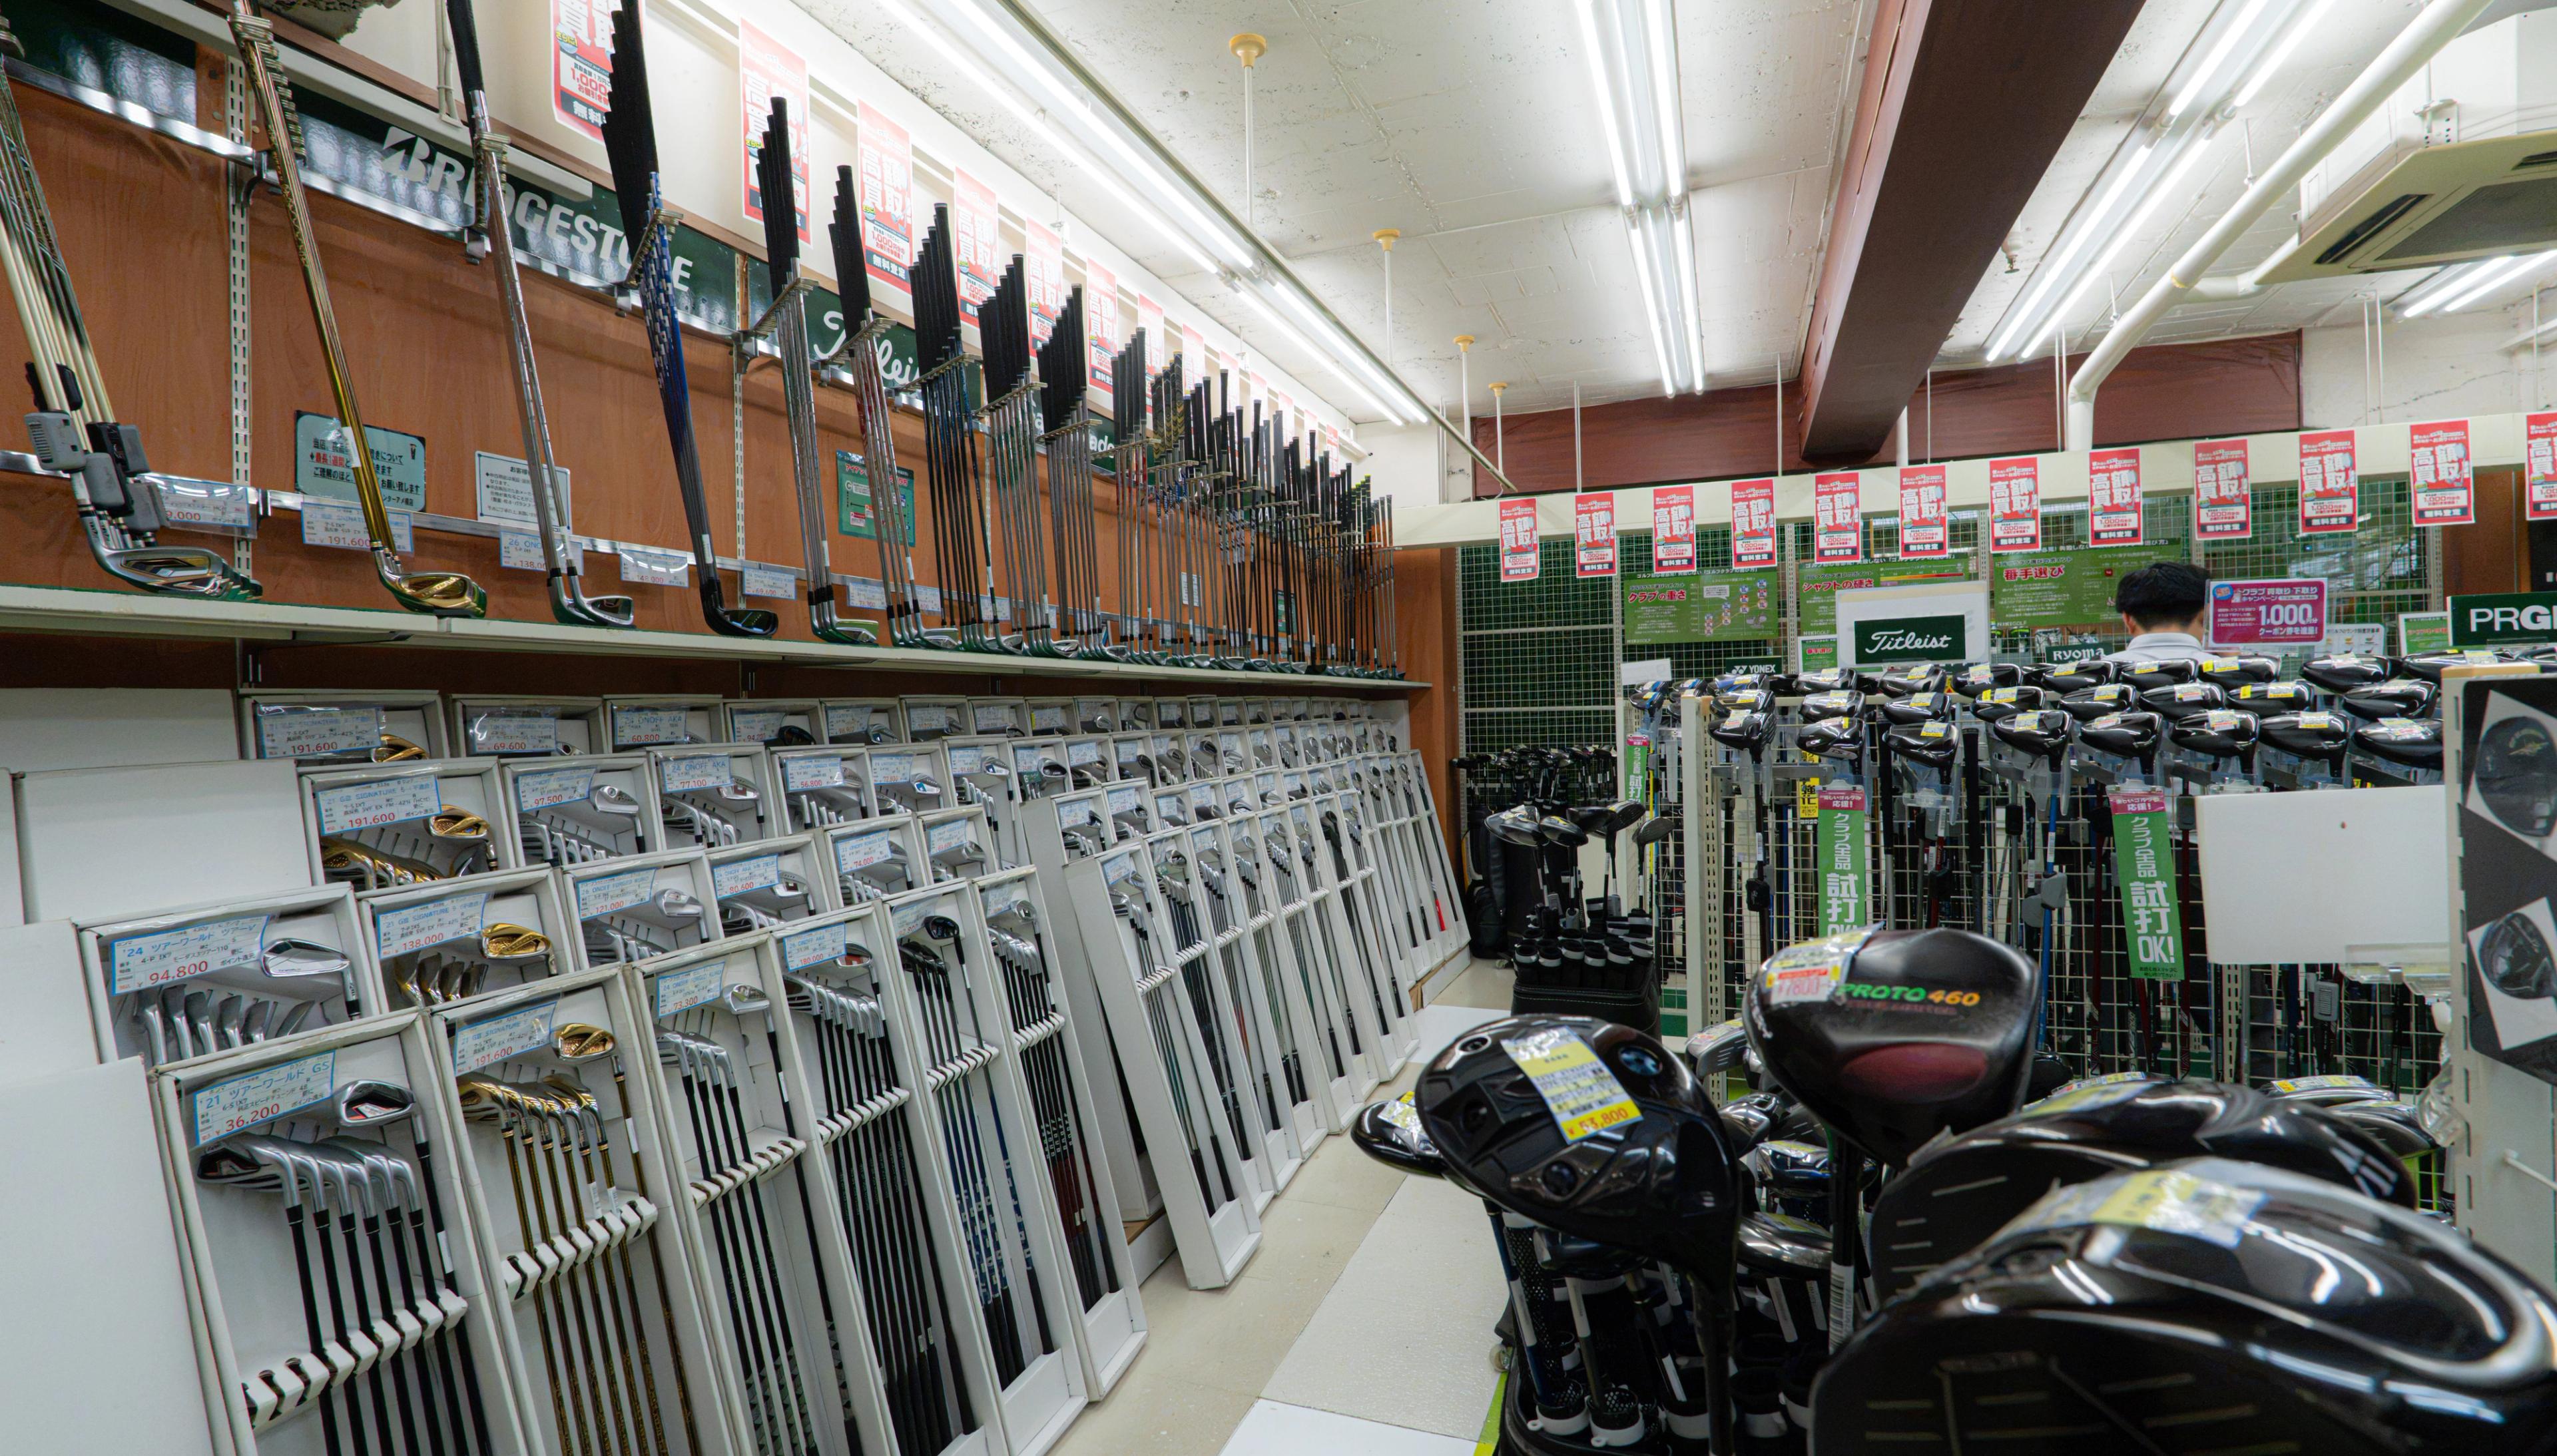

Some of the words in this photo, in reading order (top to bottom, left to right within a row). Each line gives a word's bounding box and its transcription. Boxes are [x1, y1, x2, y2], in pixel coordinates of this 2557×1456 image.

[571, 67, 607, 97] 1,000
[573, 101, 607, 126] 無料
[382, 126, 693, 292] BRGESTE
[873, 254, 906, 280] 無料査定
[519, 560, 547, 570] 138.00
[2004, 565, 2066, 581] 番手選び
[1803, 578, 1874, 593] シャフトの硬さ
[1628, 589, 1687, 603] クラブの重さ
[2470, 605, 2557, 632] PRG
[1865, 629, 1952, 654] Titleist
[1749, 664, 1776, 674] YONEX
[631, 734, 660, 742] 60.800
[291, 742, 338, 754] 191.600
[493, 742, 526, 751] 69.600
[680, 779, 707, 789] 77.100
[800, 780, 823, 788] 56.800
[356, 789, 397, 800] SIGNATURE
[534, 794, 563, 806] 97.500
[348, 812, 396, 828] 191.600
[1834, 812, 1851, 870] クラブ全品
[2131, 816, 2157, 877] クラブ全品
[854, 856, 874, 868] 74.000
[413, 907, 449, 921] SIGNATURE
[595, 901, 624, 913] 121.000
[152, 932, 214, 953] ツアーワールド
[402, 933, 444, 951] 138.000
[2137, 935, 2175, 963] OK!
[220, 952, 256, 965] ポイント還元
[800, 953, 824, 965] 180.000
[149, 960, 208, 985] 94.800
[1836, 983, 1926, 1002] PROTO
[1927, 989, 1981, 1007] 460
[673, 996, 698, 1011] 73.300
[475, 1046, 513, 1067] 191.600
[230, 1069, 305, 1099] ツアーワールド
[312, 1061, 330, 1073] GS
[225, 1103, 280, 1132] 36.200
[1579, 1108, 1629, 1134] 53,800
